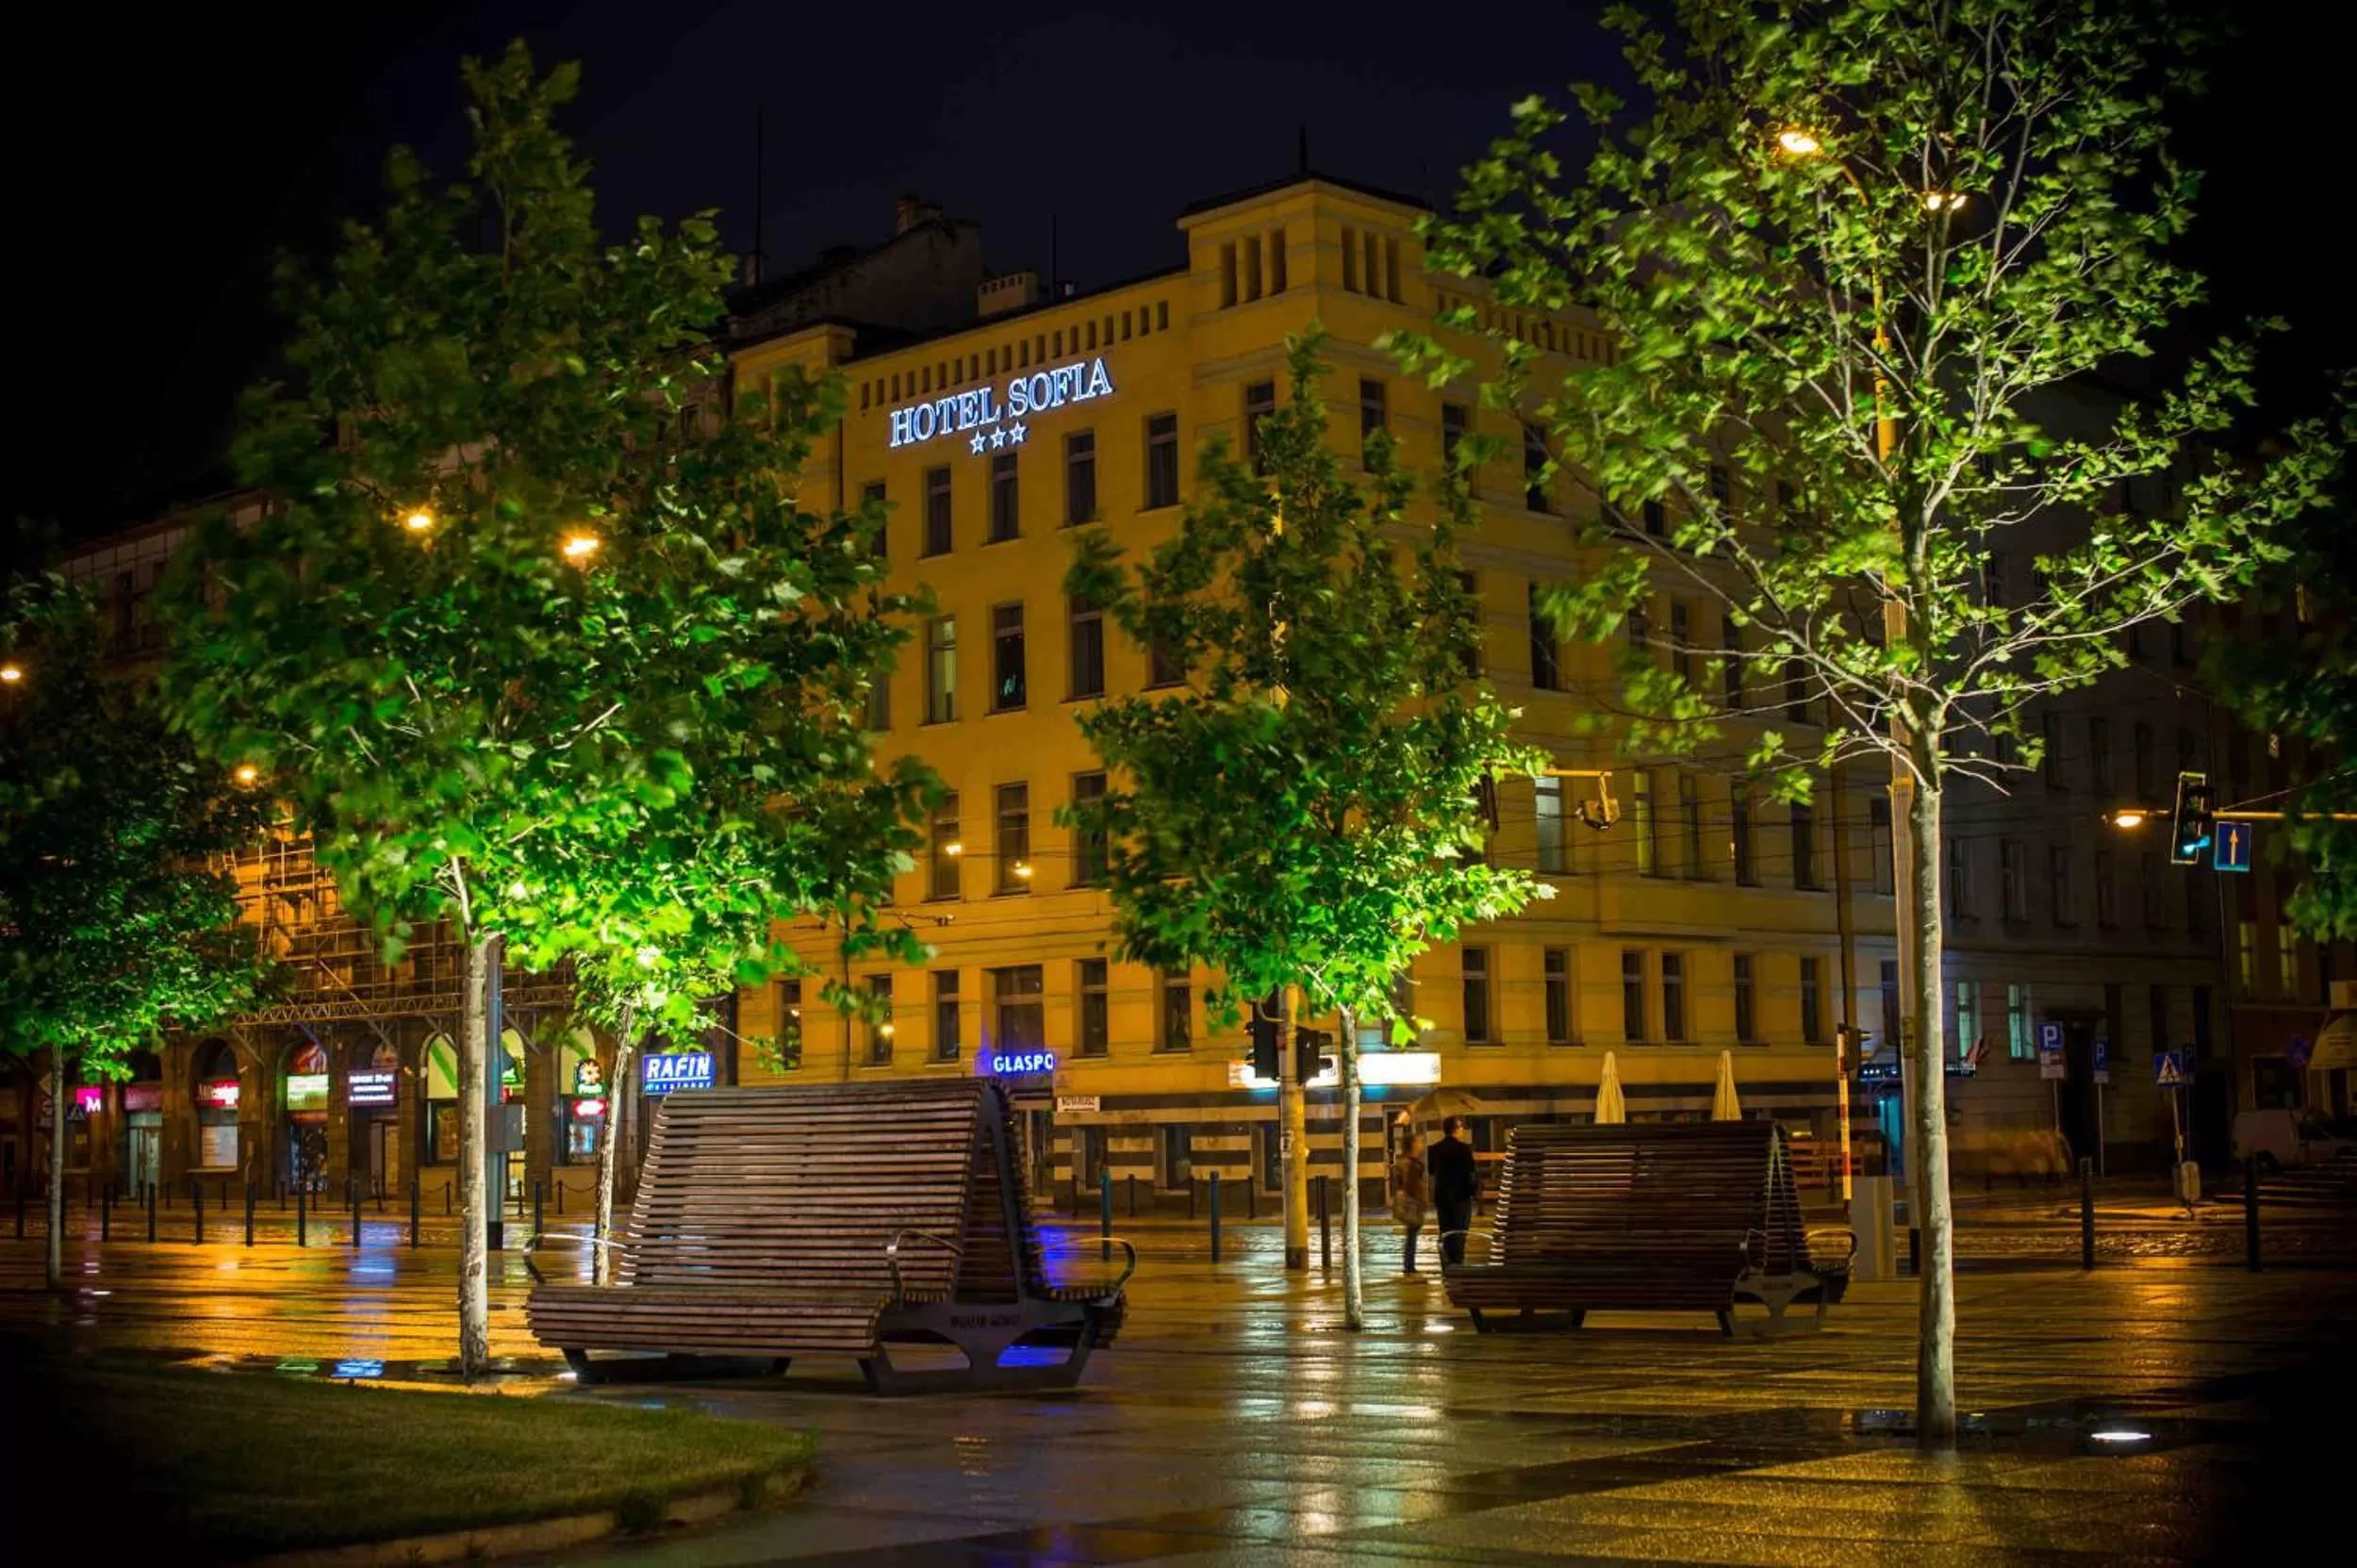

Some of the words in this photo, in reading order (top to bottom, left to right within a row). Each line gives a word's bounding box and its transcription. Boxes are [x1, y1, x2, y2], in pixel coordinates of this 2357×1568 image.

[889, 387, 1000, 448] HOTEL
[1008, 357, 1113, 418] SOFIA
[2043, 1025, 2057, 1048] P
[647, 1053, 711, 1079] RAFIN
[993, 1053, 1054, 1073] GLASPO
